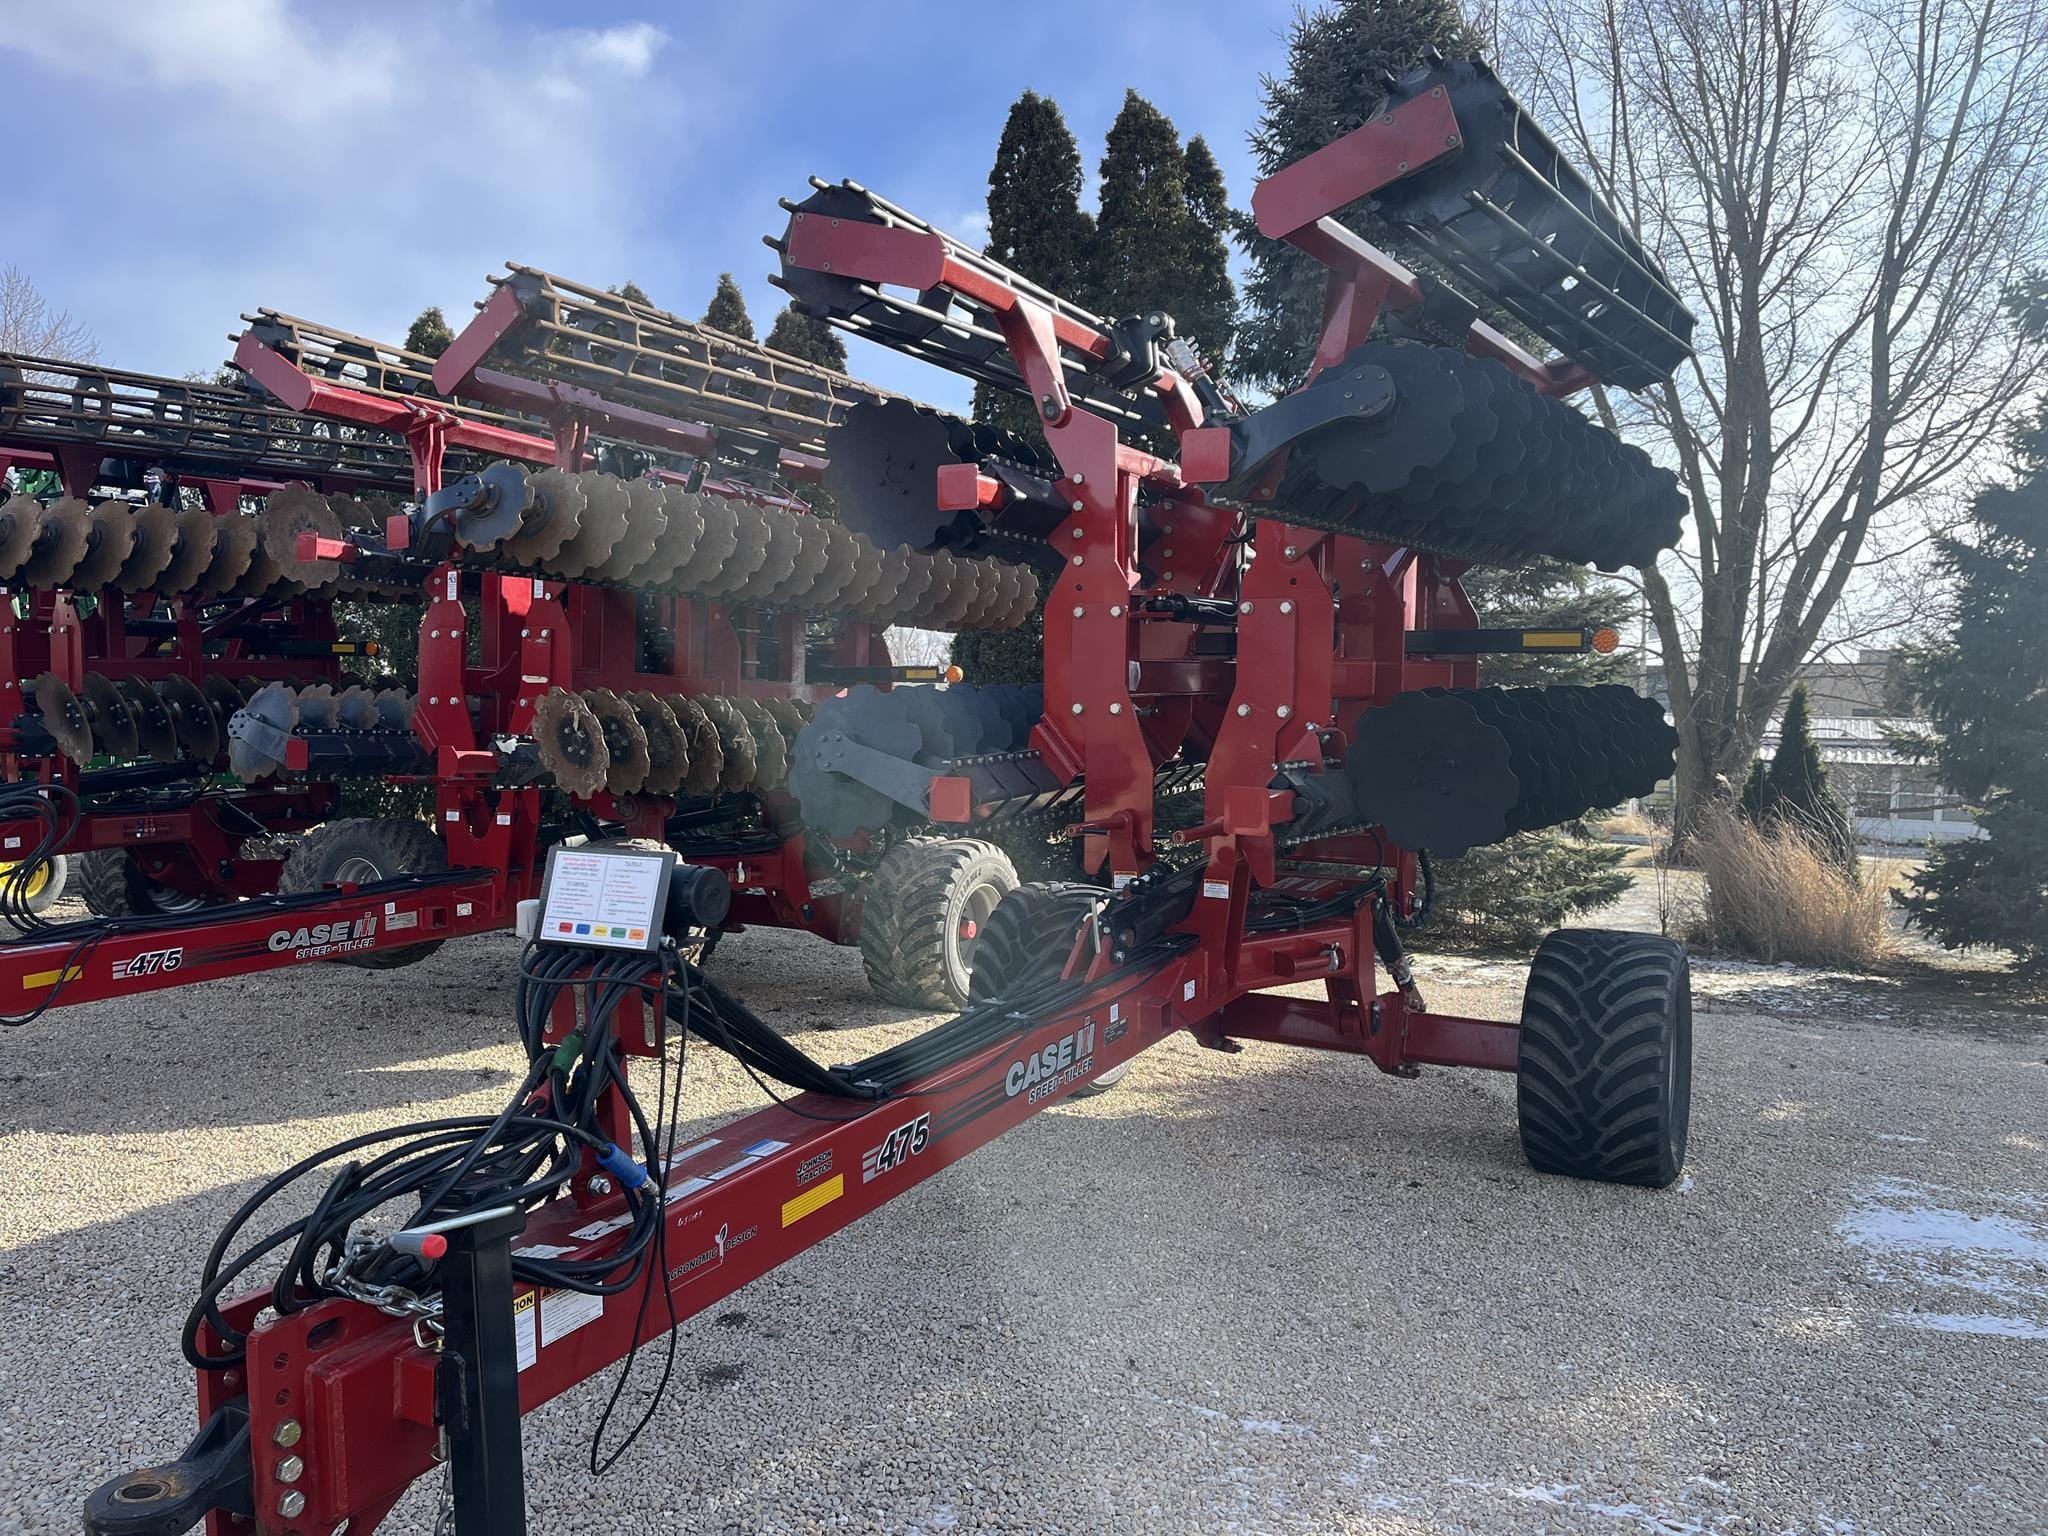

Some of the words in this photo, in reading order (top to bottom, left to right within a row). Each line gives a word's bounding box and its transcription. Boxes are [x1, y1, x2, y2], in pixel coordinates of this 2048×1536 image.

[268, 920, 350, 951] CASE
[296, 937, 375, 959] SPEED-TILLER
[127, 947, 183, 976] 475
[1005, 1033, 1074, 1097] CASE
[1028, 1056, 1093, 1104] SPEED-TILLER
[876, 1111, 931, 1173] 475
[796, 1148, 833, 1176] JOHNSON
[797, 1160, 832, 1187] TRACTOR
[725, 1225, 758, 1252] DESIGN
